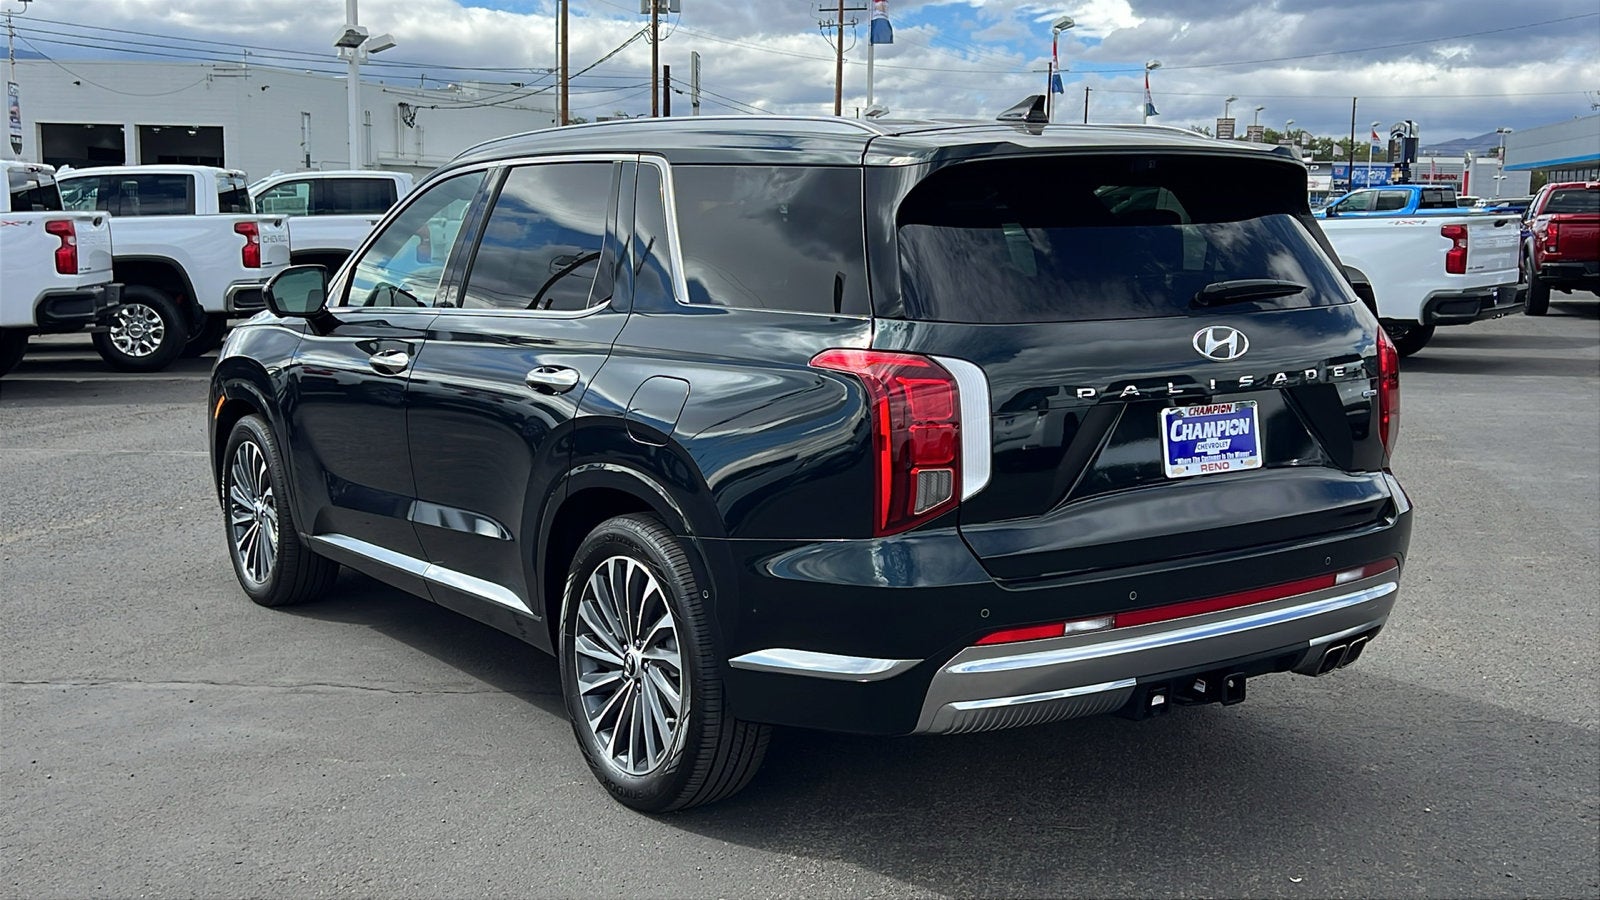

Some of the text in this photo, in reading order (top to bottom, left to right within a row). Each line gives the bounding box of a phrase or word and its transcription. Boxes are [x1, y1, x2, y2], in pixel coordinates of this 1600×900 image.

[1076, 365, 1346, 399] PALISADE
[1188, 403, 1233, 416] CHAMPION
[1197, 441, 1229, 451] CHEVROLET
[1200, 461, 1230, 472] RENO
